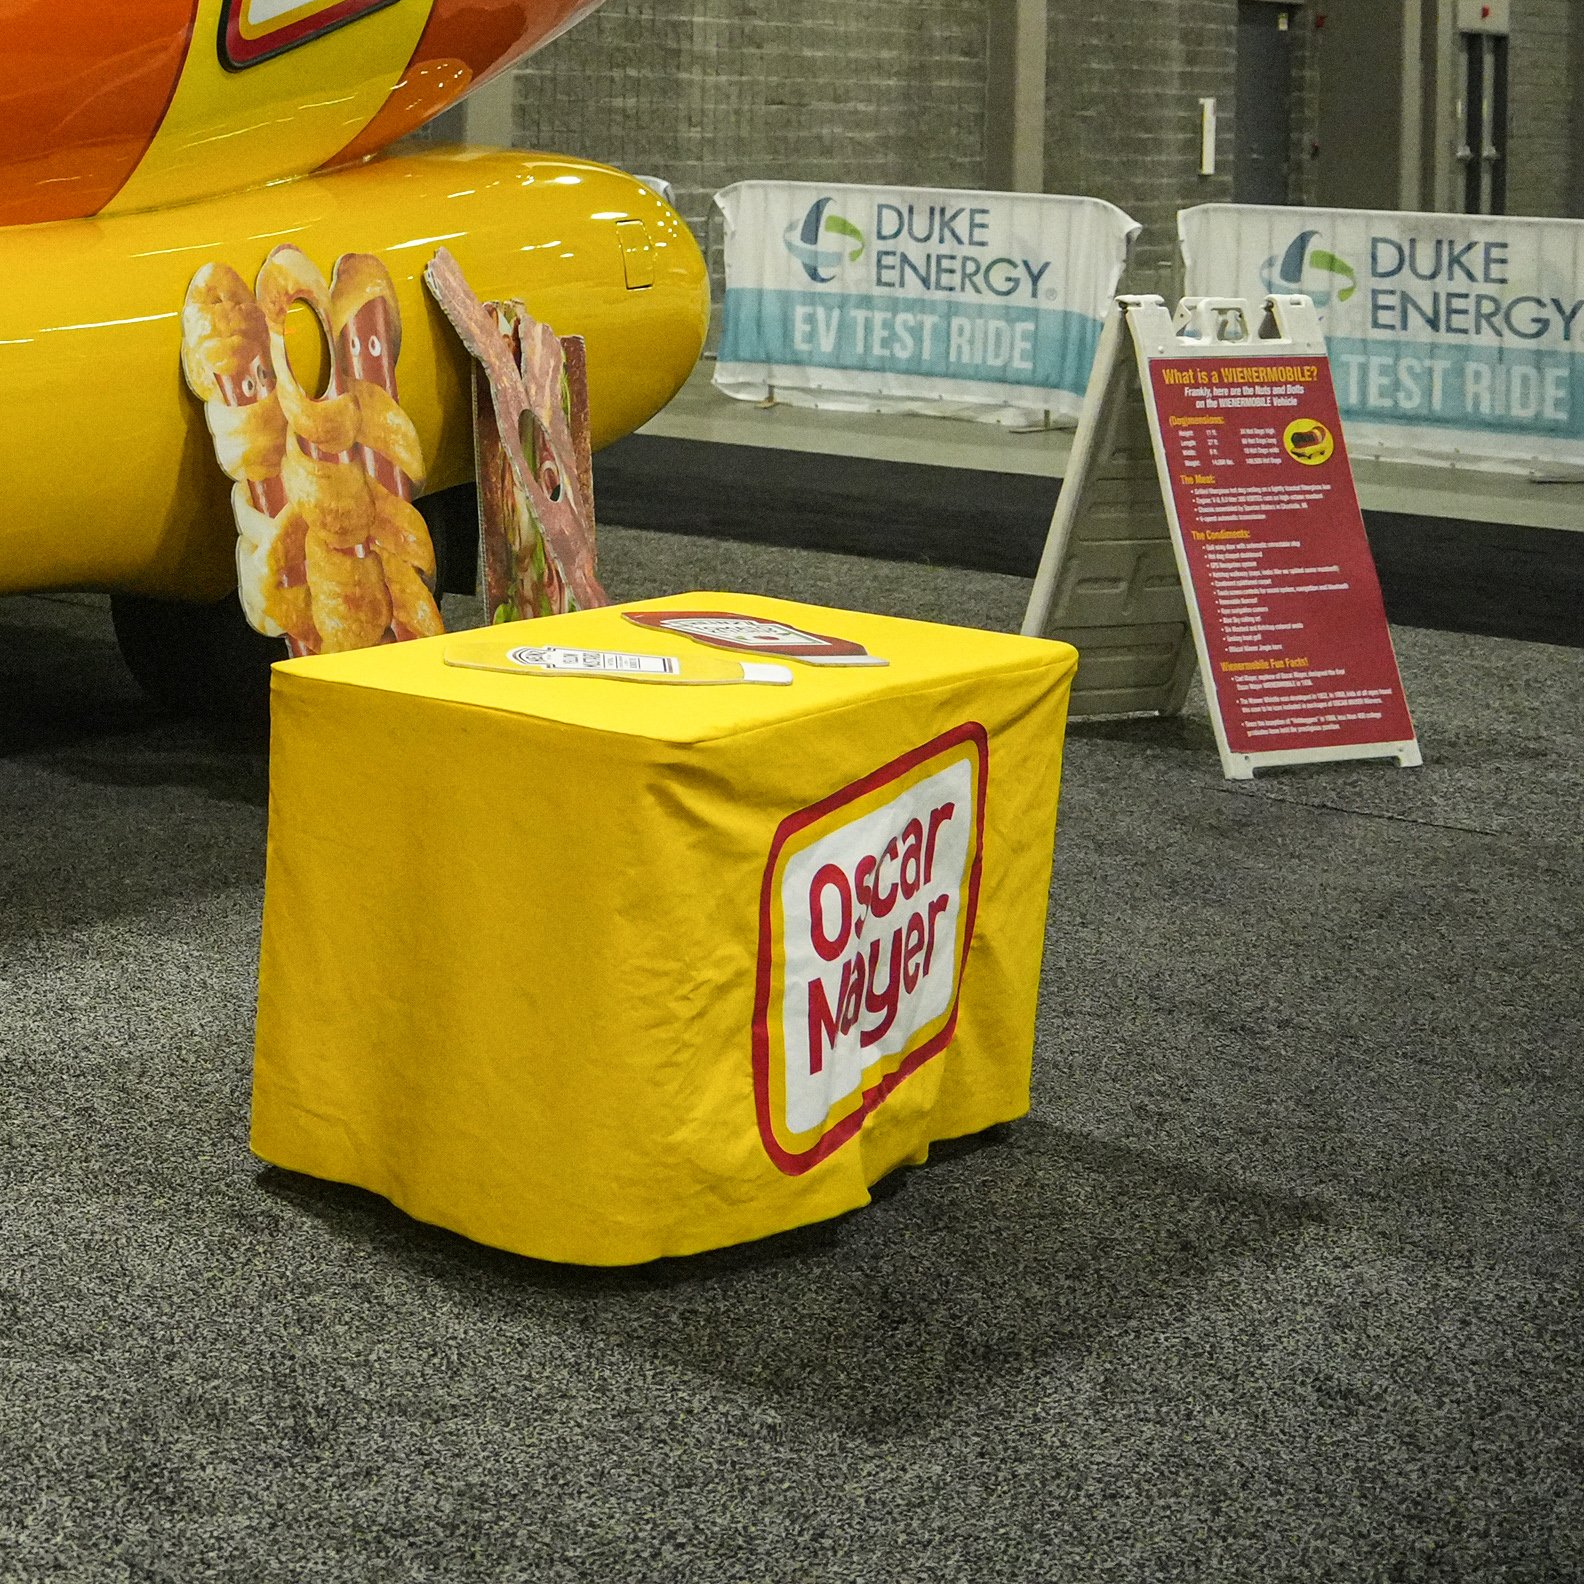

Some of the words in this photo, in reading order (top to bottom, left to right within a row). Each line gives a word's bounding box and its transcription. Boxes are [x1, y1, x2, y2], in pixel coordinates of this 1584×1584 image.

[876, 204, 990, 248] DUKE
[1371, 237, 1508, 284] DUKE
[794, 304, 836, 348] EV
[848, 308, 937, 360] TEST
[948, 317, 1036, 370] RIDE
[1371, 289, 1584, 341] ENERGY
[1162, 368, 1195, 384] What
[1197, 368, 1208, 384] is
[1212, 371, 1219, 383] a
[1221, 366, 1318, 383] WIENERMOBILE?
[1184, 386, 1212, 397] Frankly,
[1213, 386, 1229, 395] here
[1230, 387, 1241, 395] are
[1243, 386, 1254, 395] the
[1273, 385, 1285, 394] and
[1340, 354, 1451, 410] TEST
[1465, 362, 1570, 420] RIDE
[1206, 398, 1217, 408] the
[1180, 475, 1194, 484] The
[1192, 531, 1205, 540] The
[1270, 658, 1284, 669] Fun
[809, 801, 955, 962] Oscar
[808, 893, 950, 1076] Mayer
